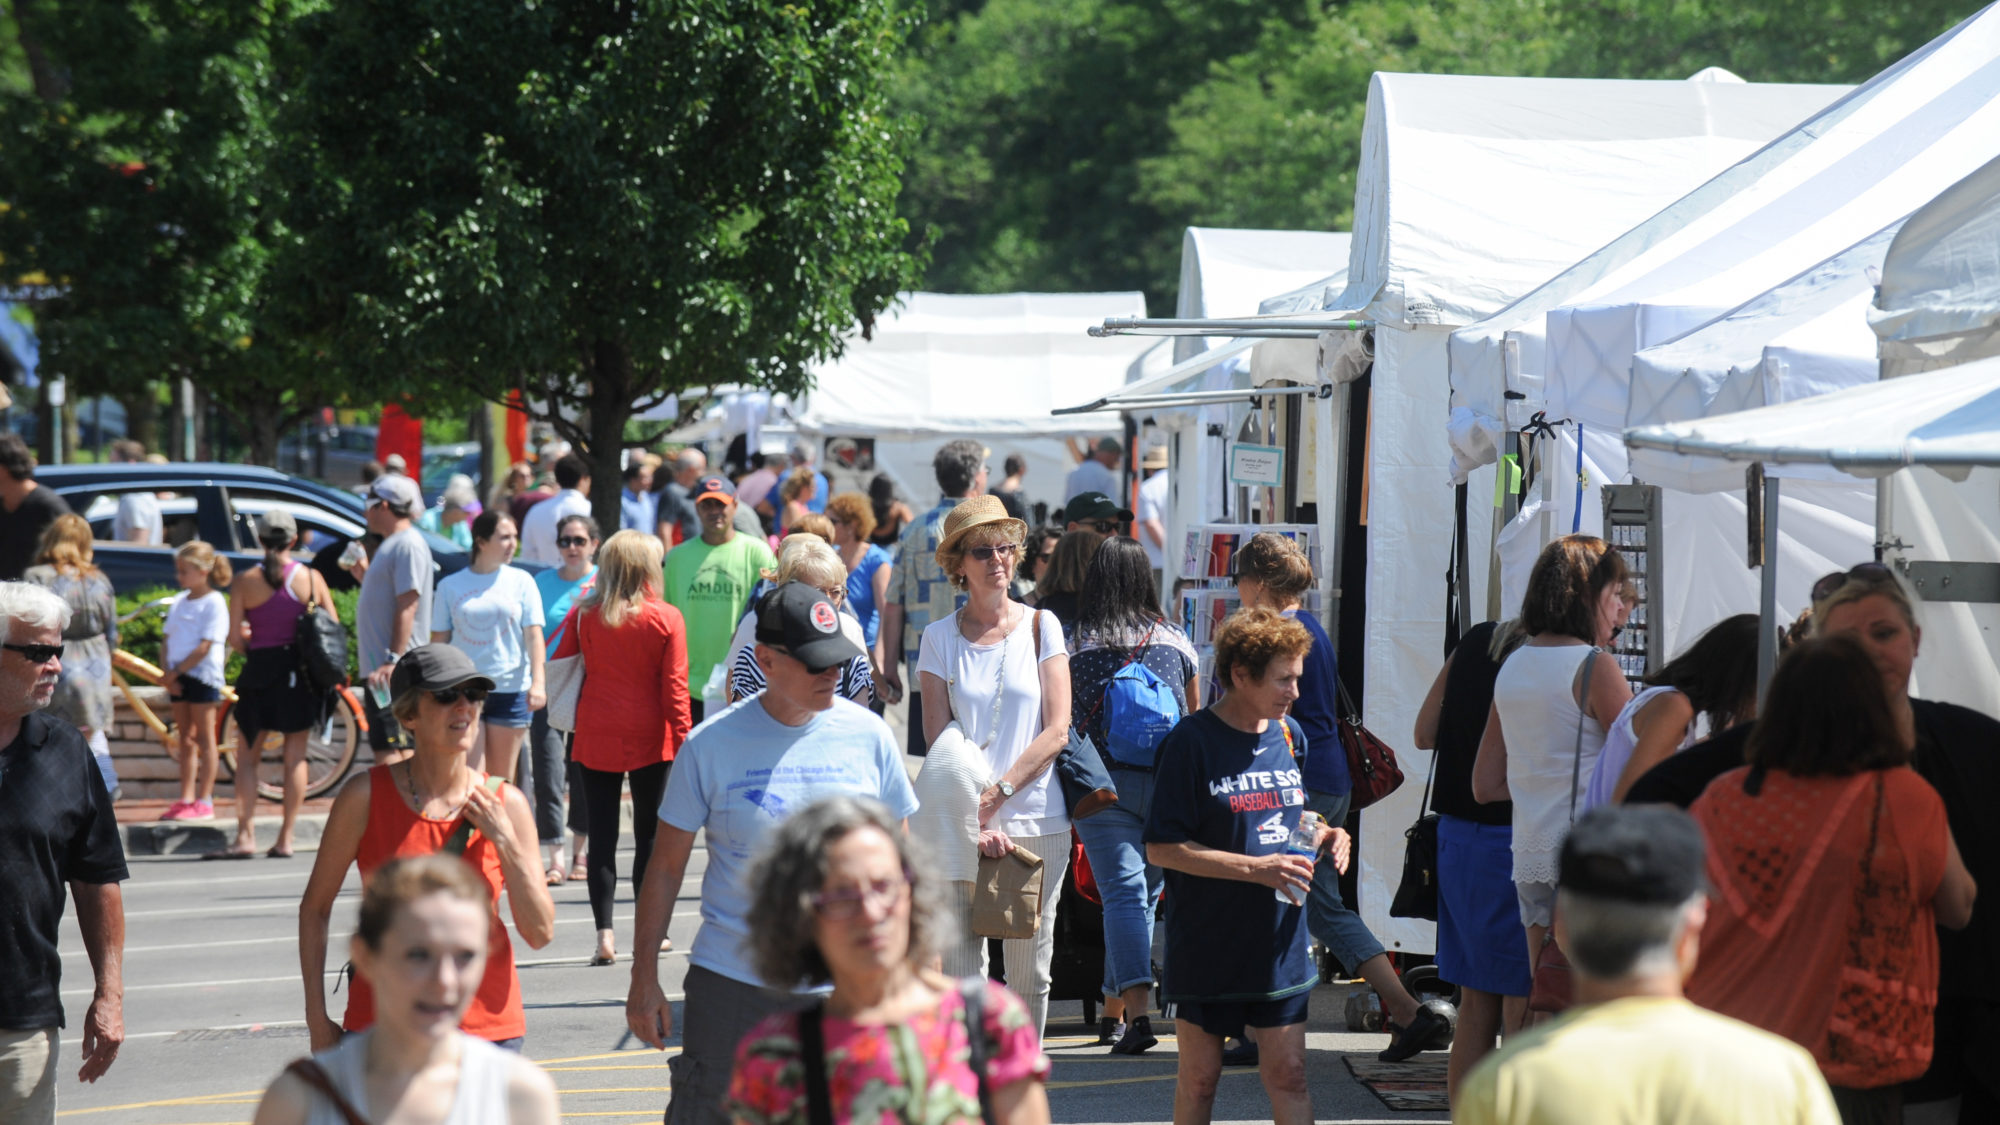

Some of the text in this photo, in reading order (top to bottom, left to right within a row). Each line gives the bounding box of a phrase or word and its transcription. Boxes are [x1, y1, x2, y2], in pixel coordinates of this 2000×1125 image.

[1210, 772, 1274, 796] WHITE
[1230, 792, 1283, 812] BASEBALL
[1259, 834, 1290, 844] SOX
